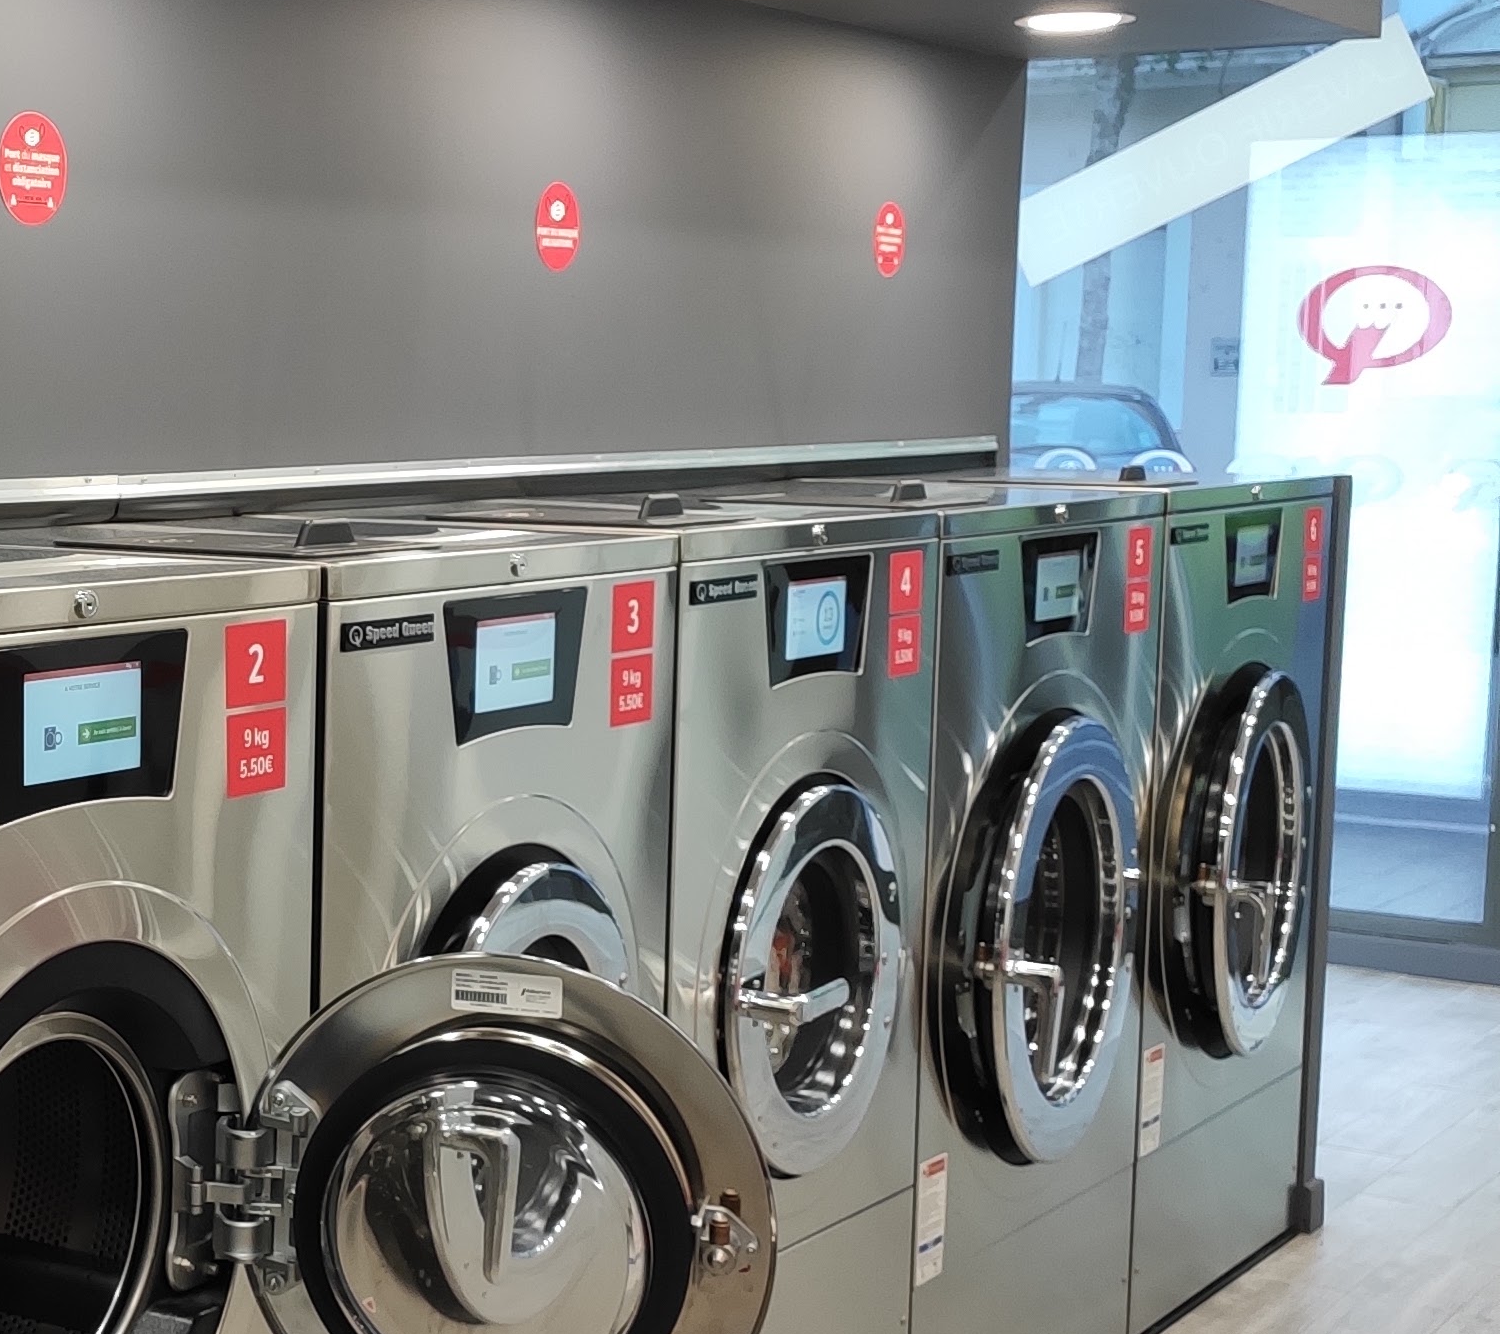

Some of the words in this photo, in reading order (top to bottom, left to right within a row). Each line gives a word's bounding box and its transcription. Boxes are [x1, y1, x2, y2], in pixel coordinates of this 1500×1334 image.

[1135, 539, 1144, 566] 5
[900, 566, 911, 597] 4
[626, 598, 640, 634] 3
[365, 621, 399, 644] Speed
[248, 643, 265, 684] 2
[621, 670, 629, 686] 9
[629, 668, 641, 689] kg
[243, 727, 254, 748] 9
[254, 726, 270, 751] kg
[239, 756, 274, 779] 5.50€
